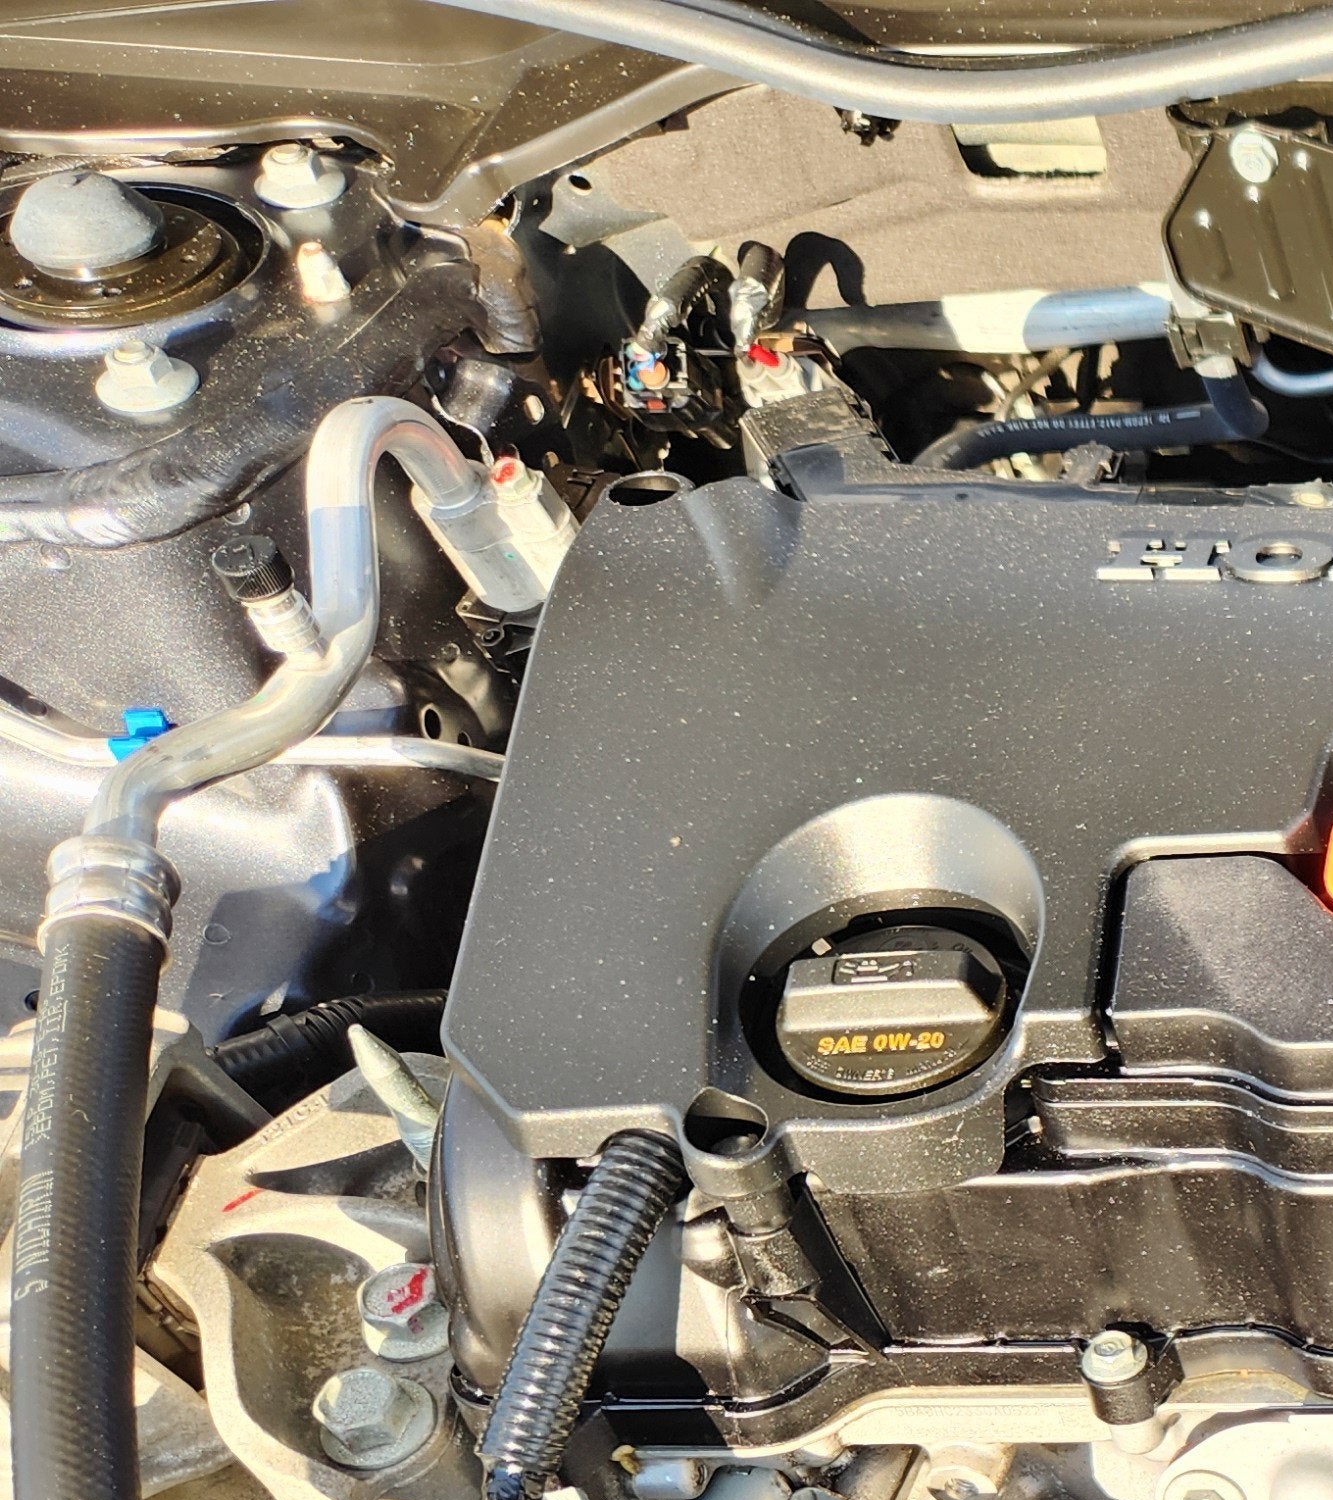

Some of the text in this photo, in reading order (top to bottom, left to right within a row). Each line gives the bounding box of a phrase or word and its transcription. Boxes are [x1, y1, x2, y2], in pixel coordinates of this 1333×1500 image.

[817, 1030, 946, 1056] SAE 0W-20
[14, 1170, 54, 1274] NICHIRIN
